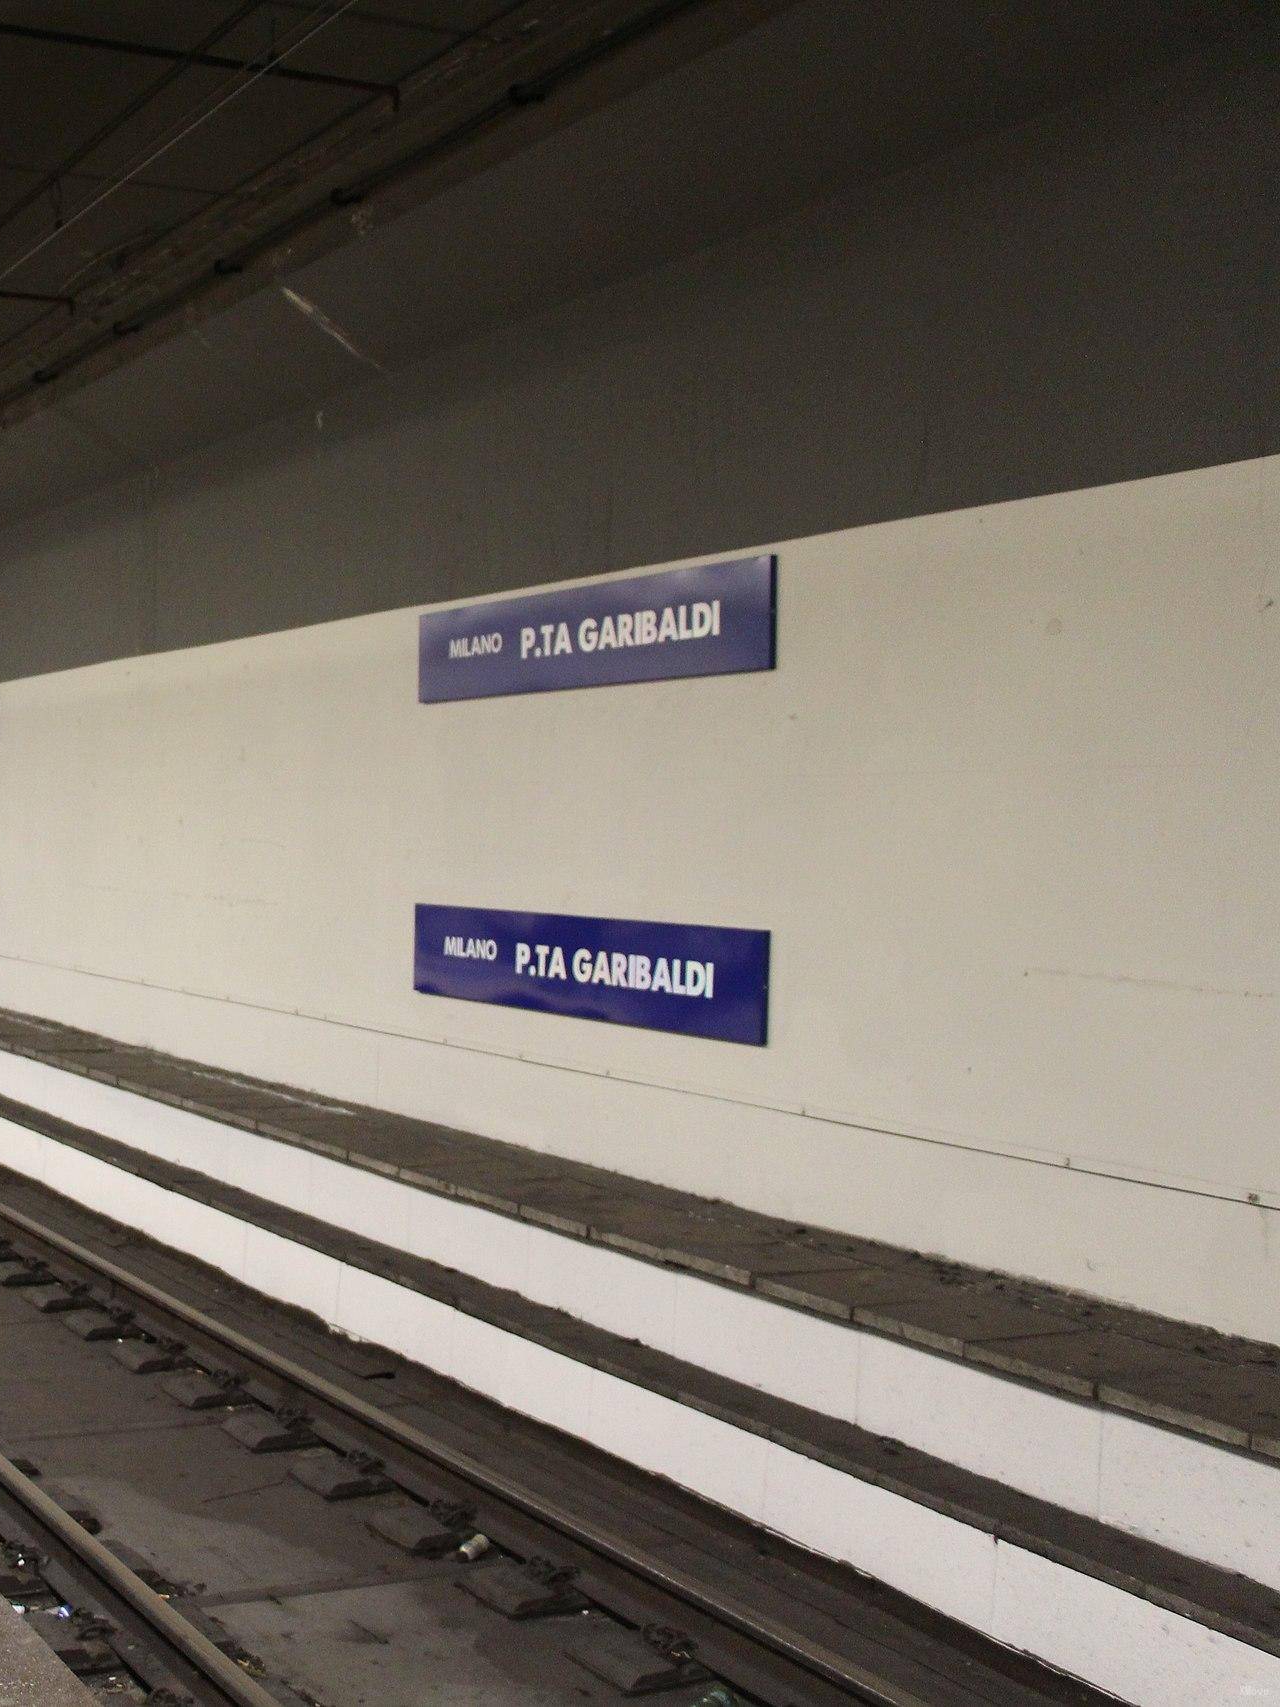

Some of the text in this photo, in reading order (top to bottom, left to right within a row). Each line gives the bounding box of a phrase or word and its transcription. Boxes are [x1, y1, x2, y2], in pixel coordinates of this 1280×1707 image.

[449, 599, 721, 660] MILANO P.TA GARIBALDI
[443, 935, 715, 999] MILANO P.TA GARIBALDI
